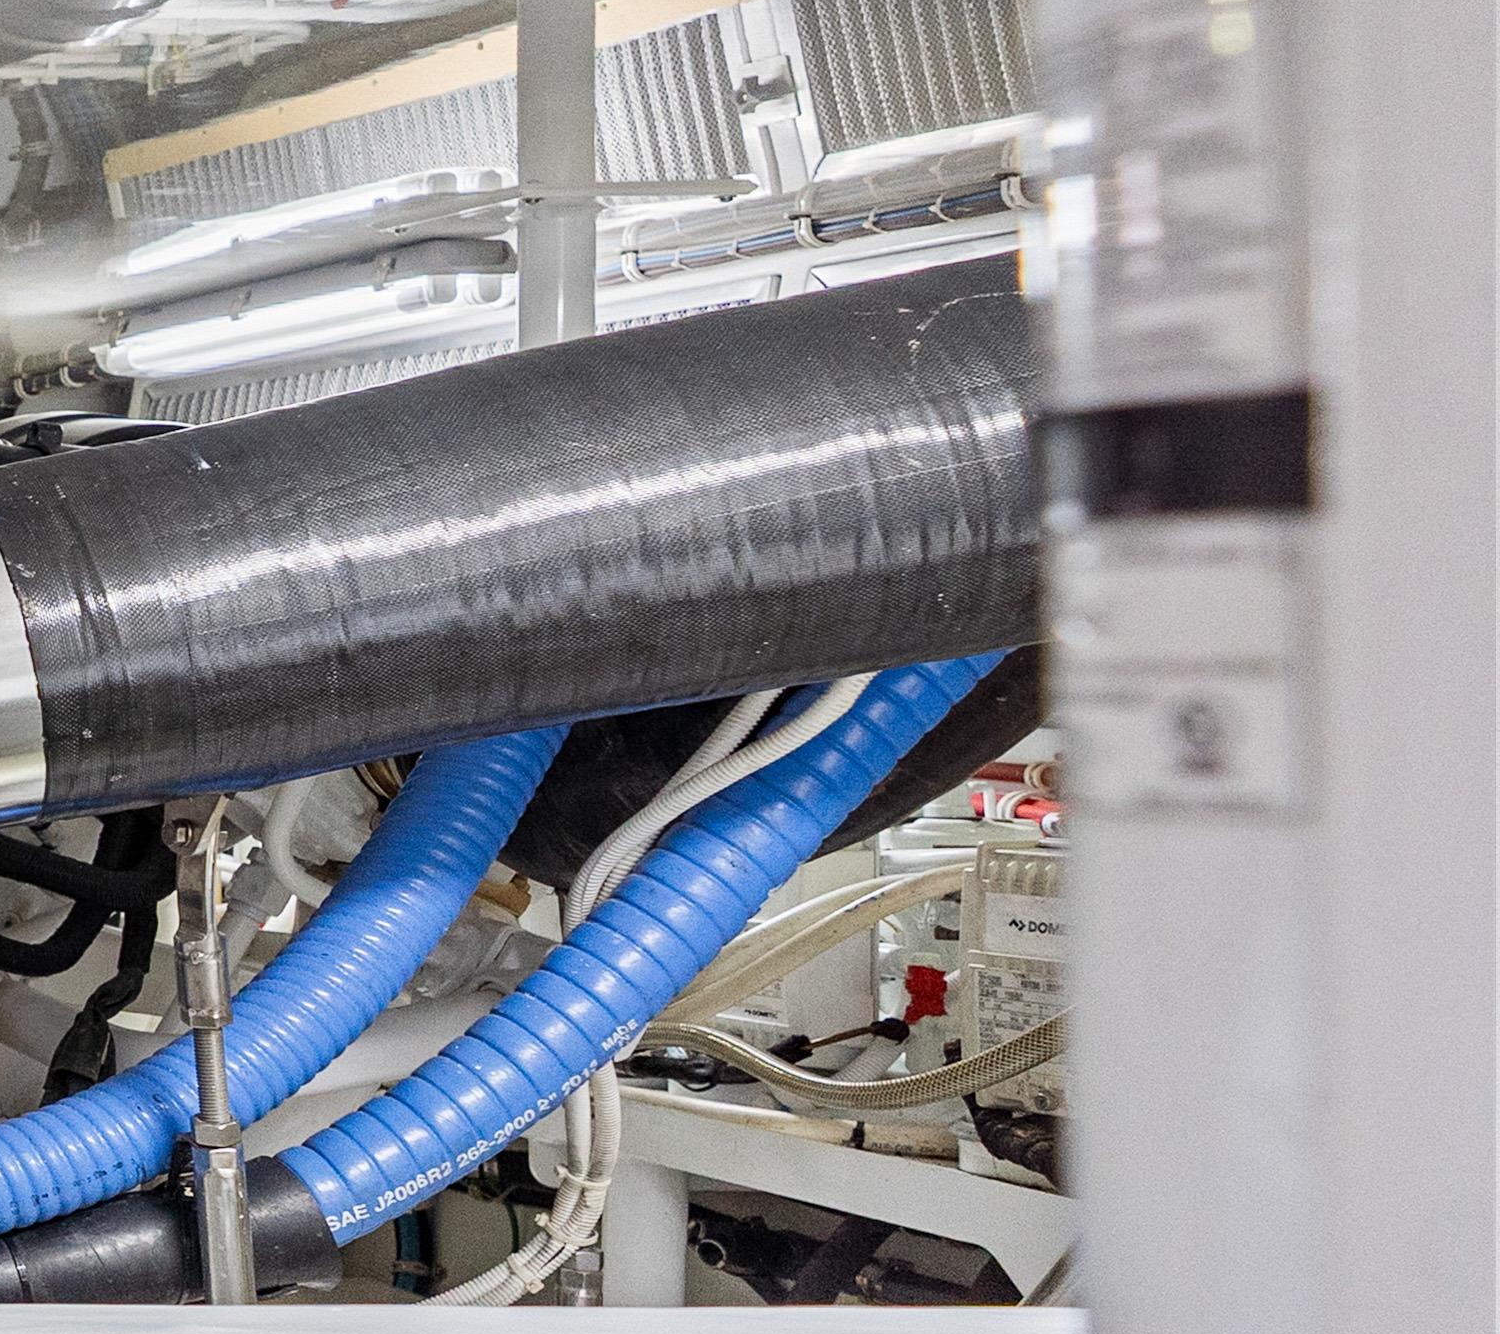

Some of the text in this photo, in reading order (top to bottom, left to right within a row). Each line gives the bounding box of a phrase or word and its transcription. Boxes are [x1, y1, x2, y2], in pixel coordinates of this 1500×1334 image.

[601, 1018, 639, 1053] MADE
[326, 1205, 370, 1234] SAE
[373, 1158, 451, 1213] J2006R2
[456, 1109, 537, 1170] 262-2000
